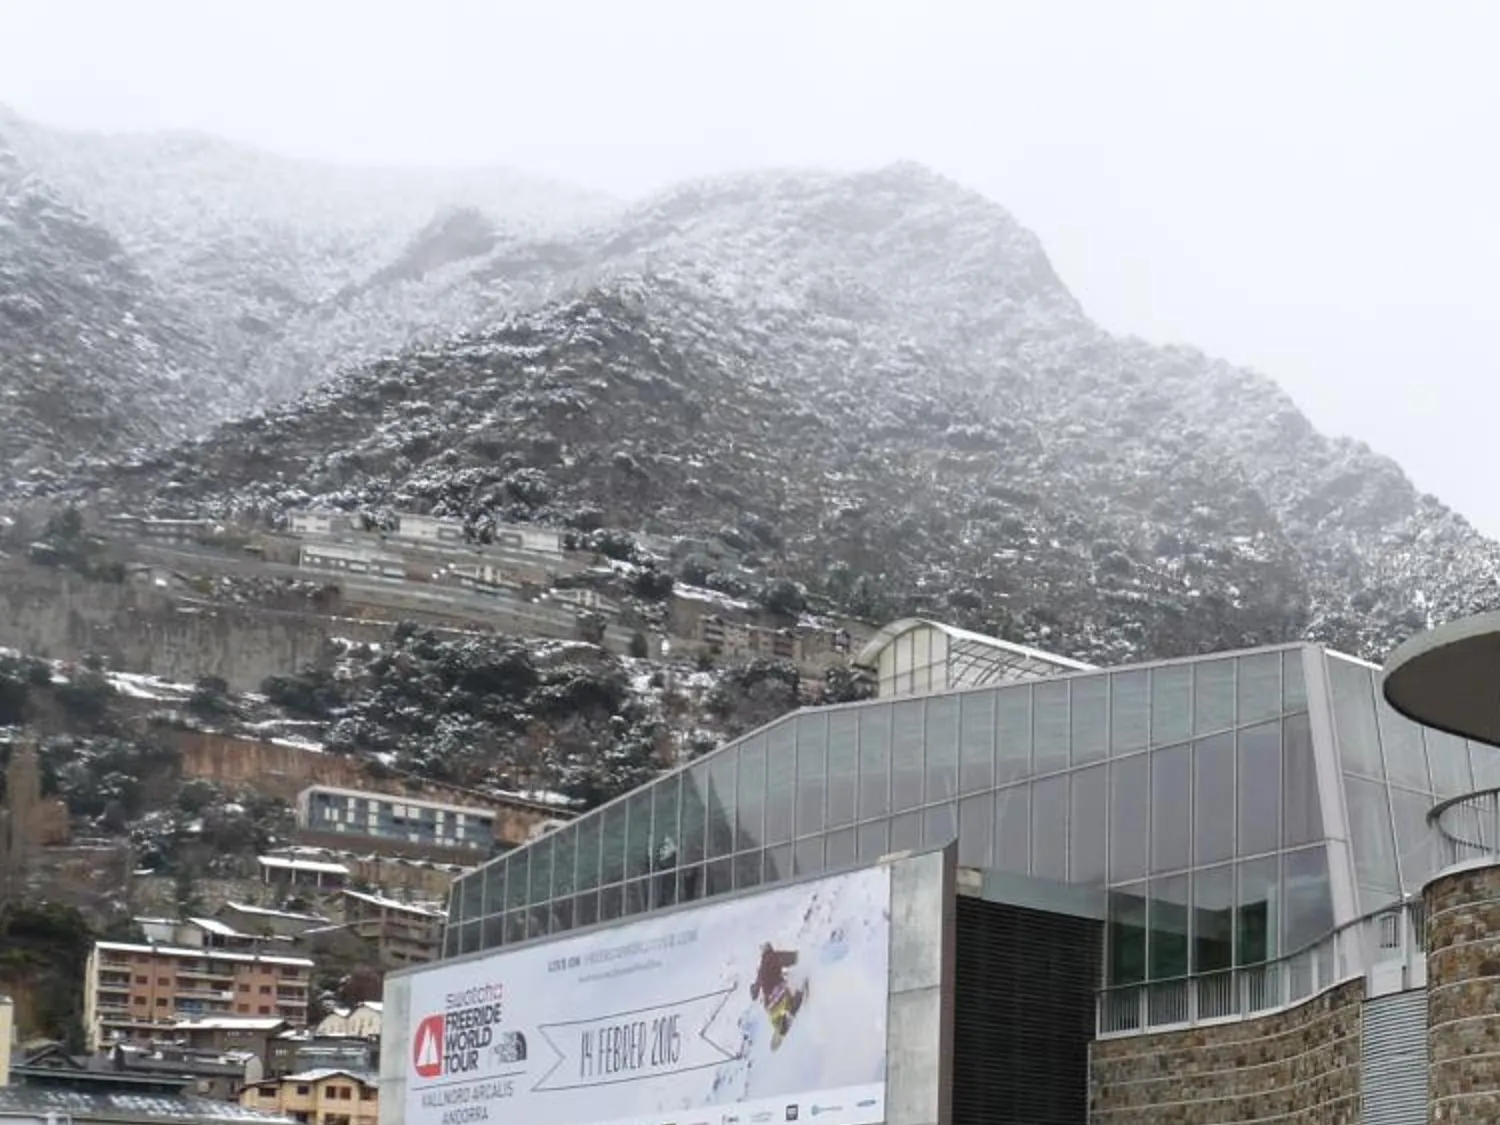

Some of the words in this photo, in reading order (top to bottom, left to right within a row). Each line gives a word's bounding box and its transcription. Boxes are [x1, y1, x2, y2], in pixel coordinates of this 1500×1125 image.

[446, 1002, 502, 1030] FREERIDE
[446, 1026, 493, 1052] WORLD
[581, 1030, 593, 1077] 14
[598, 1021, 647, 1075] FEBRER
[651, 1014, 680, 1066] 2015
[443, 1049, 479, 1075] TOUR
[442, 1106, 488, 1125] ANDORRA
